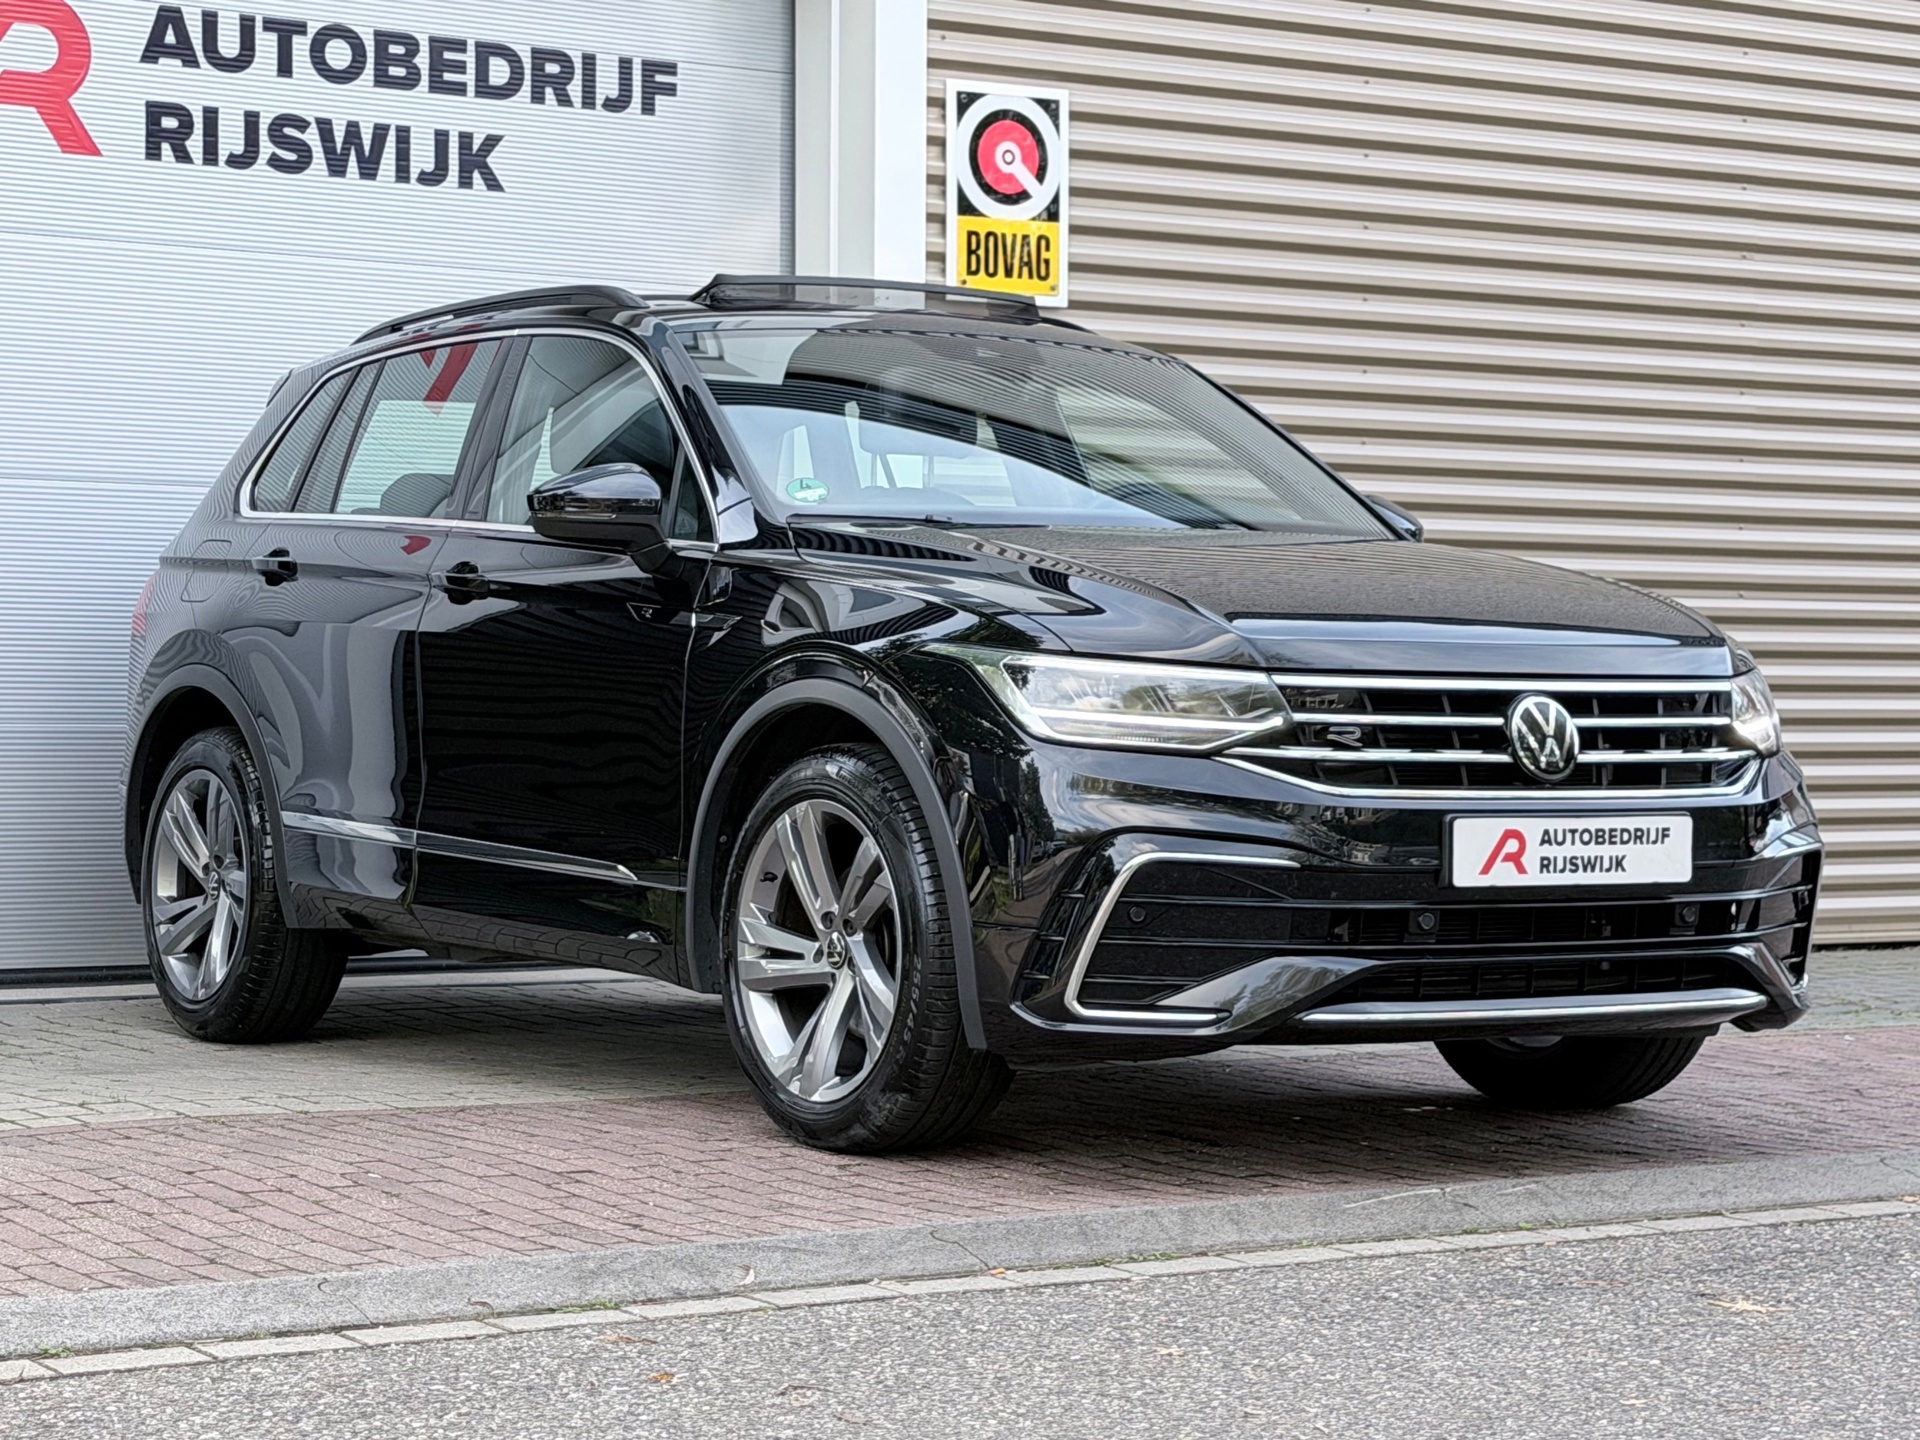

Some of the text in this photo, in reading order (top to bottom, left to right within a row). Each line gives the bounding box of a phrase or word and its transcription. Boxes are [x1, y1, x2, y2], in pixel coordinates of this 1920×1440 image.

[140, 5, 678, 116] AUTOBEDRIJF
[145, 100, 506, 192] RIJSWIJK
[966, 230, 1051, 281] BOVAG
[1326, 726, 1363, 747] R
[1539, 827, 1671, 846] AUTOBEDRIJF
[1539, 855, 1627, 875] RIJSWIJK
